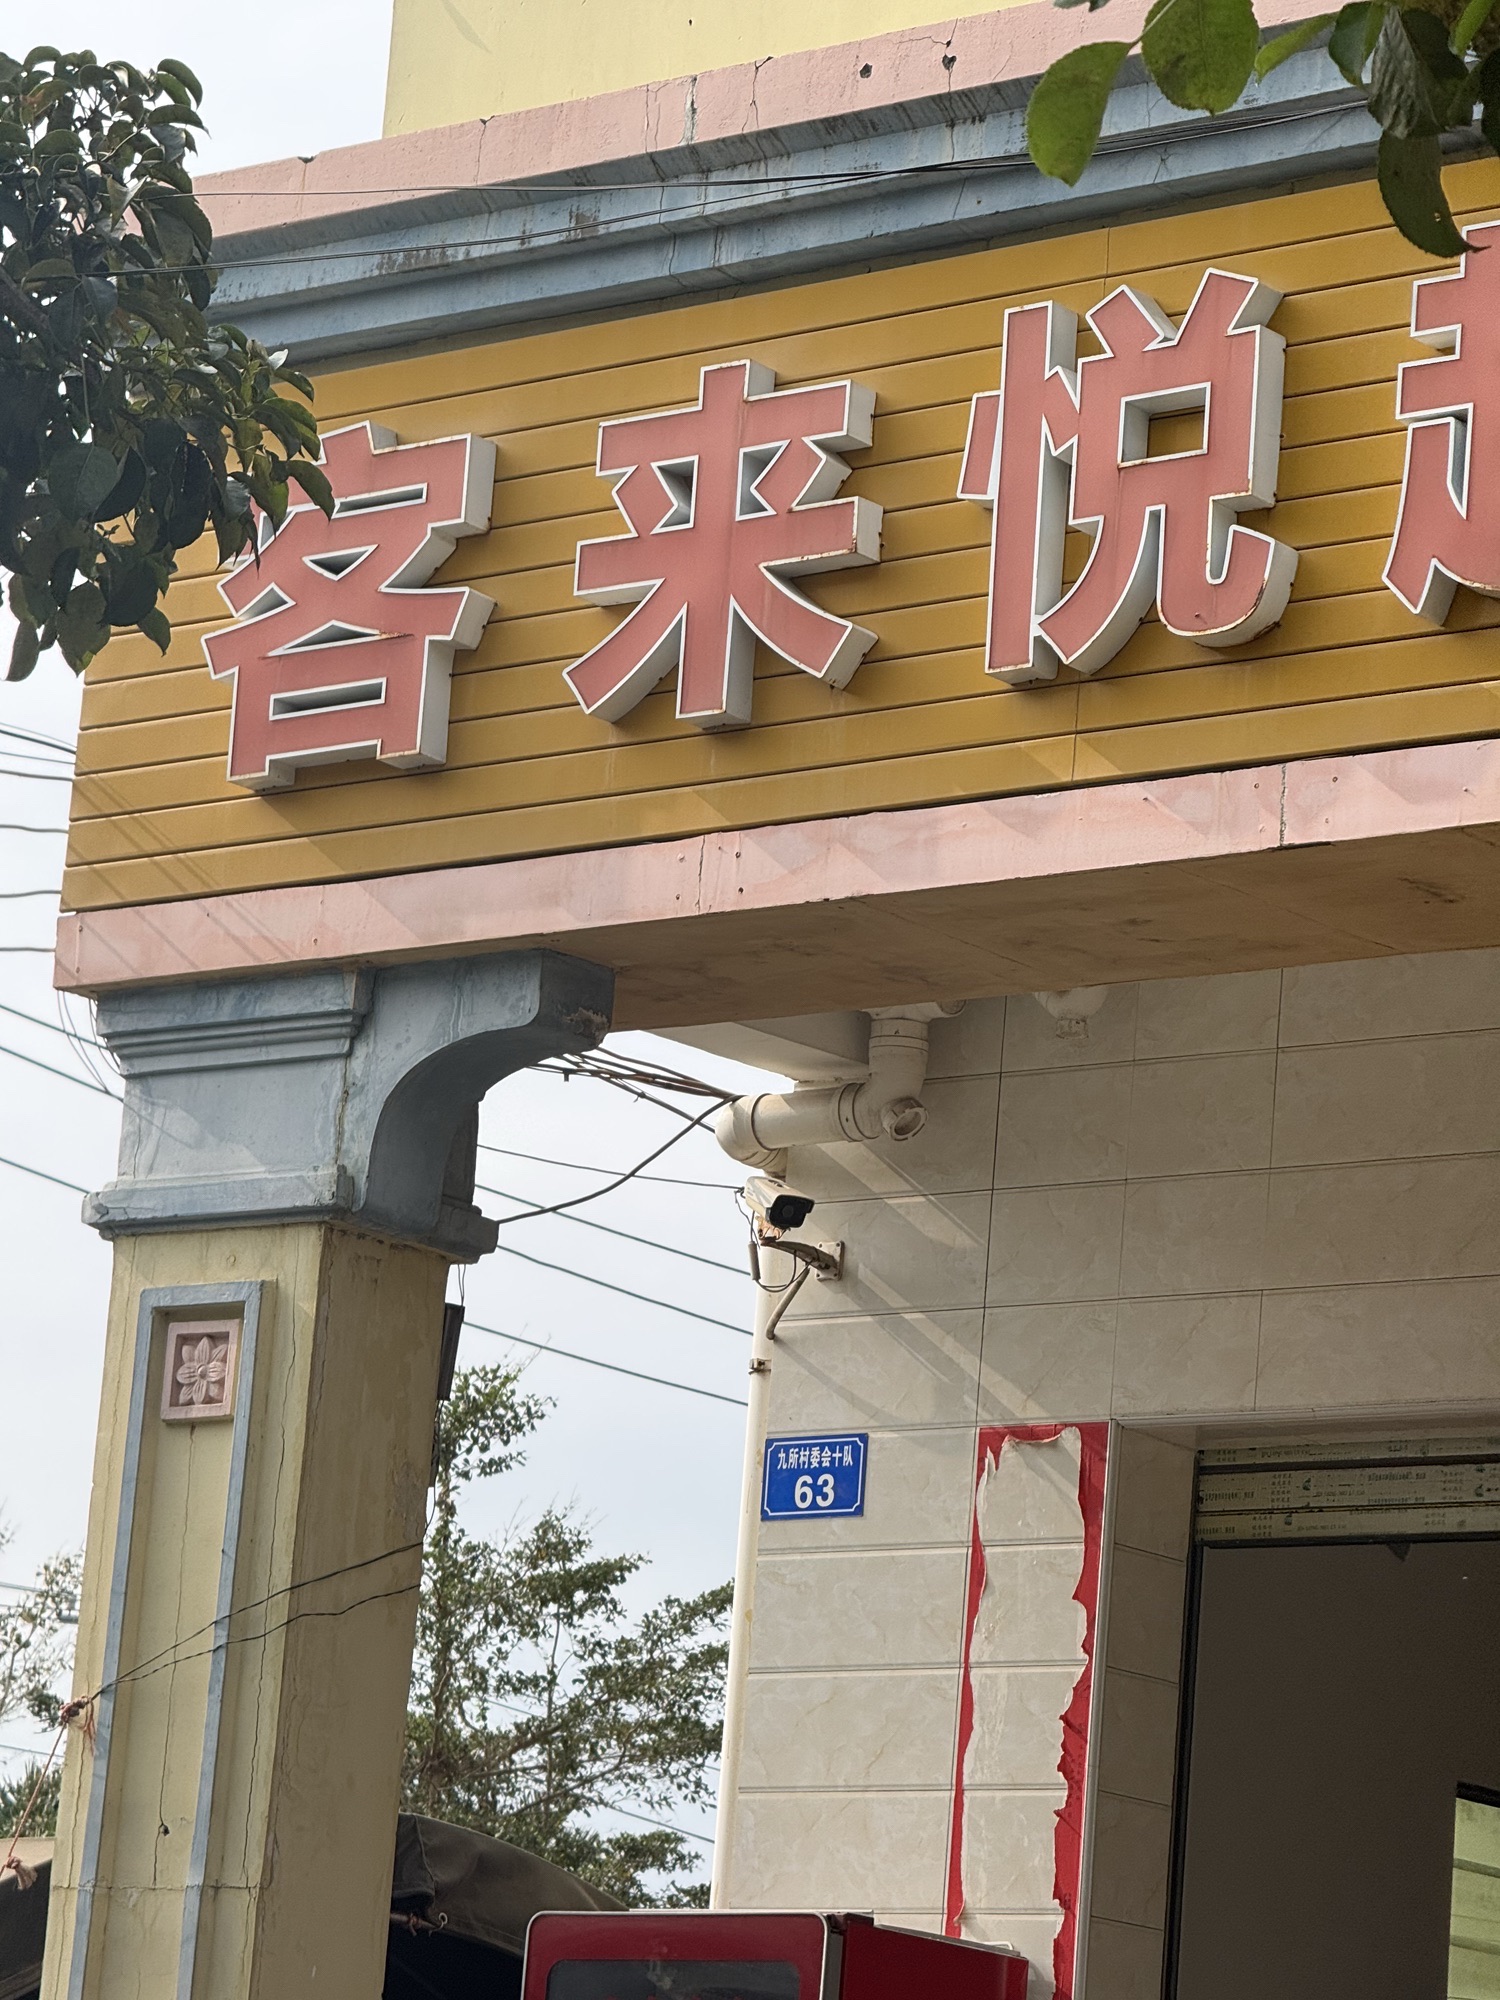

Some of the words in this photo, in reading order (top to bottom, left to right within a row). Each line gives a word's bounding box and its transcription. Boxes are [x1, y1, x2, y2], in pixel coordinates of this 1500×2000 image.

[777, 1444, 853, 1470] 九所村委会十队
[794, 1473, 835, 1509] 63
